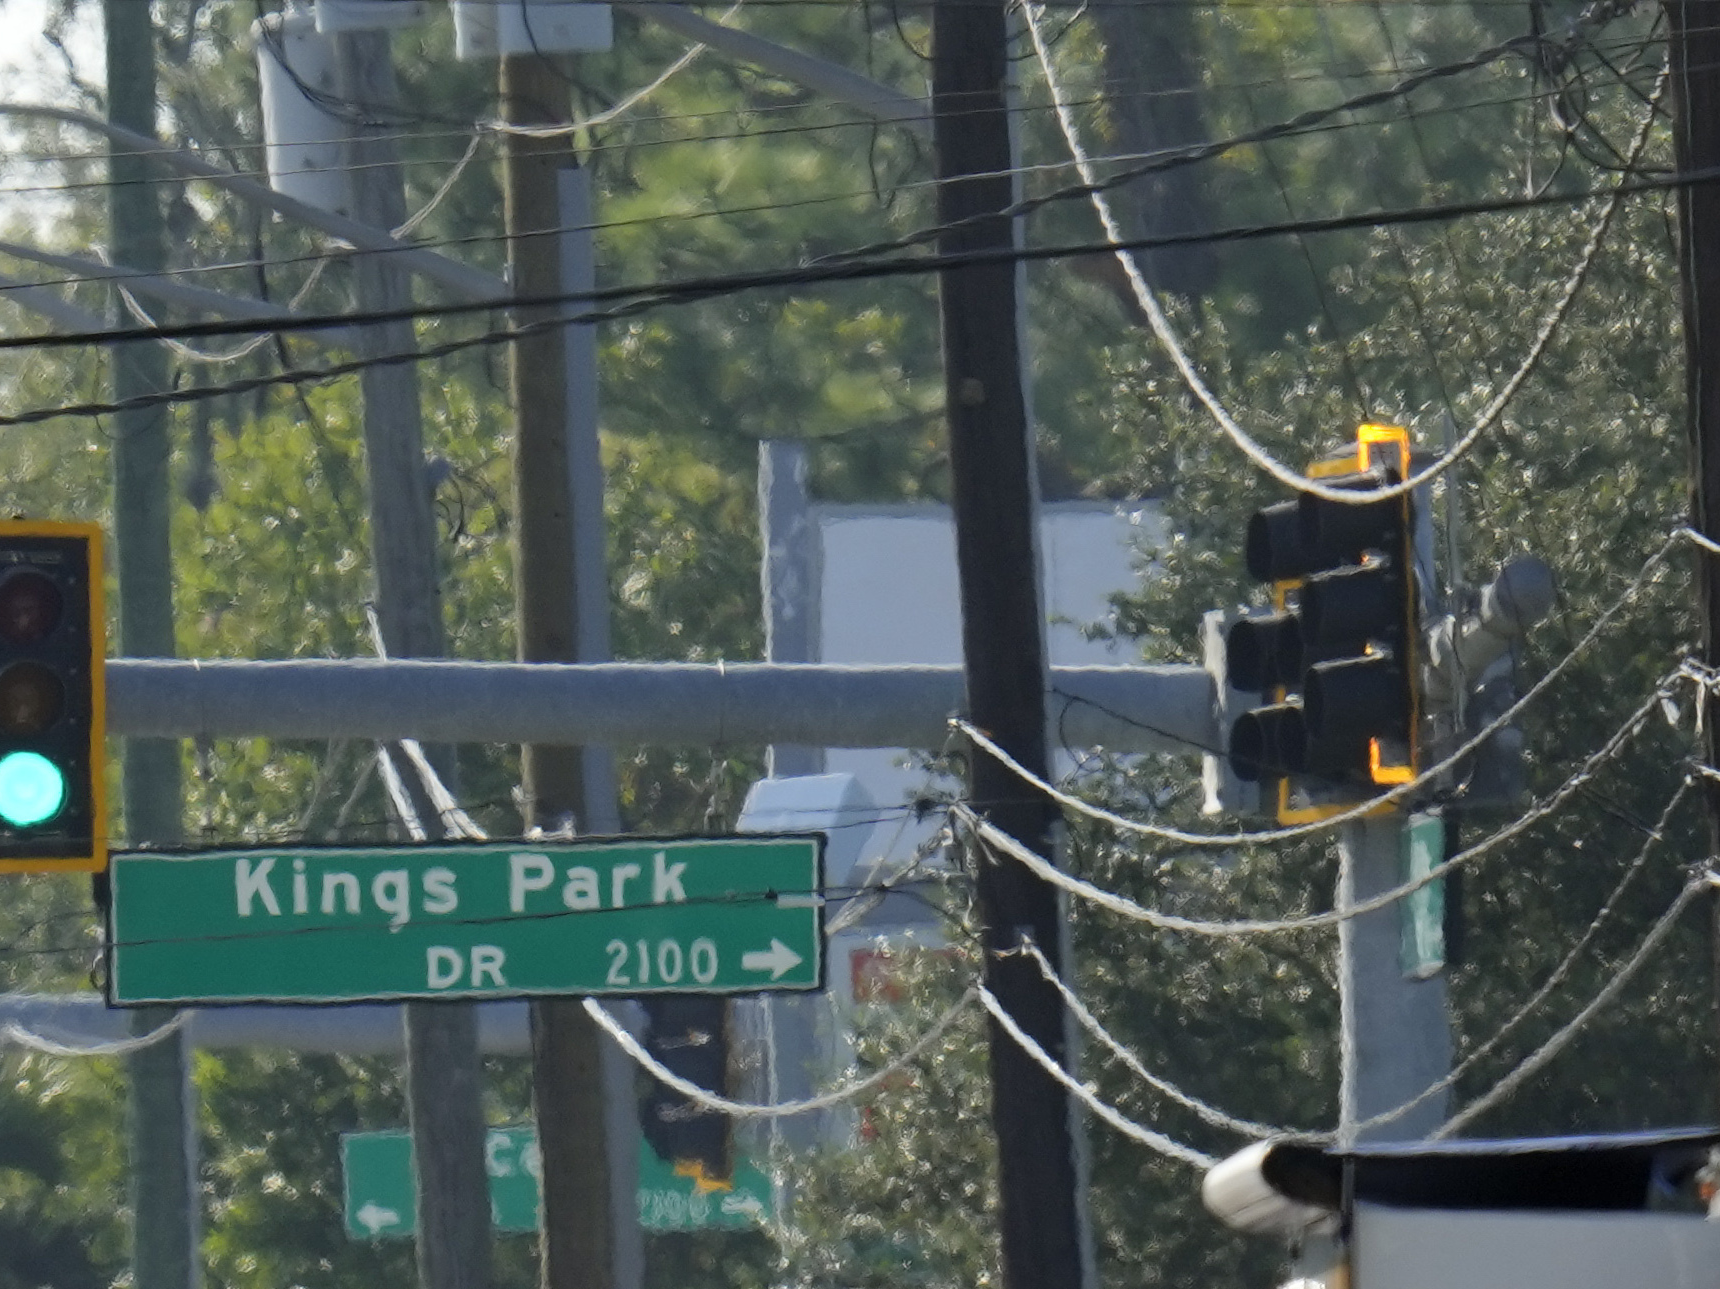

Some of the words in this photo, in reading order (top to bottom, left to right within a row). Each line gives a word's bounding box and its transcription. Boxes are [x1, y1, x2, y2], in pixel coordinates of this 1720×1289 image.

[234, 857, 459, 934] Kings
[508, 851, 688, 913] Park
[426, 945, 507, 990] DR
[605, 936, 719, 986] 2100
